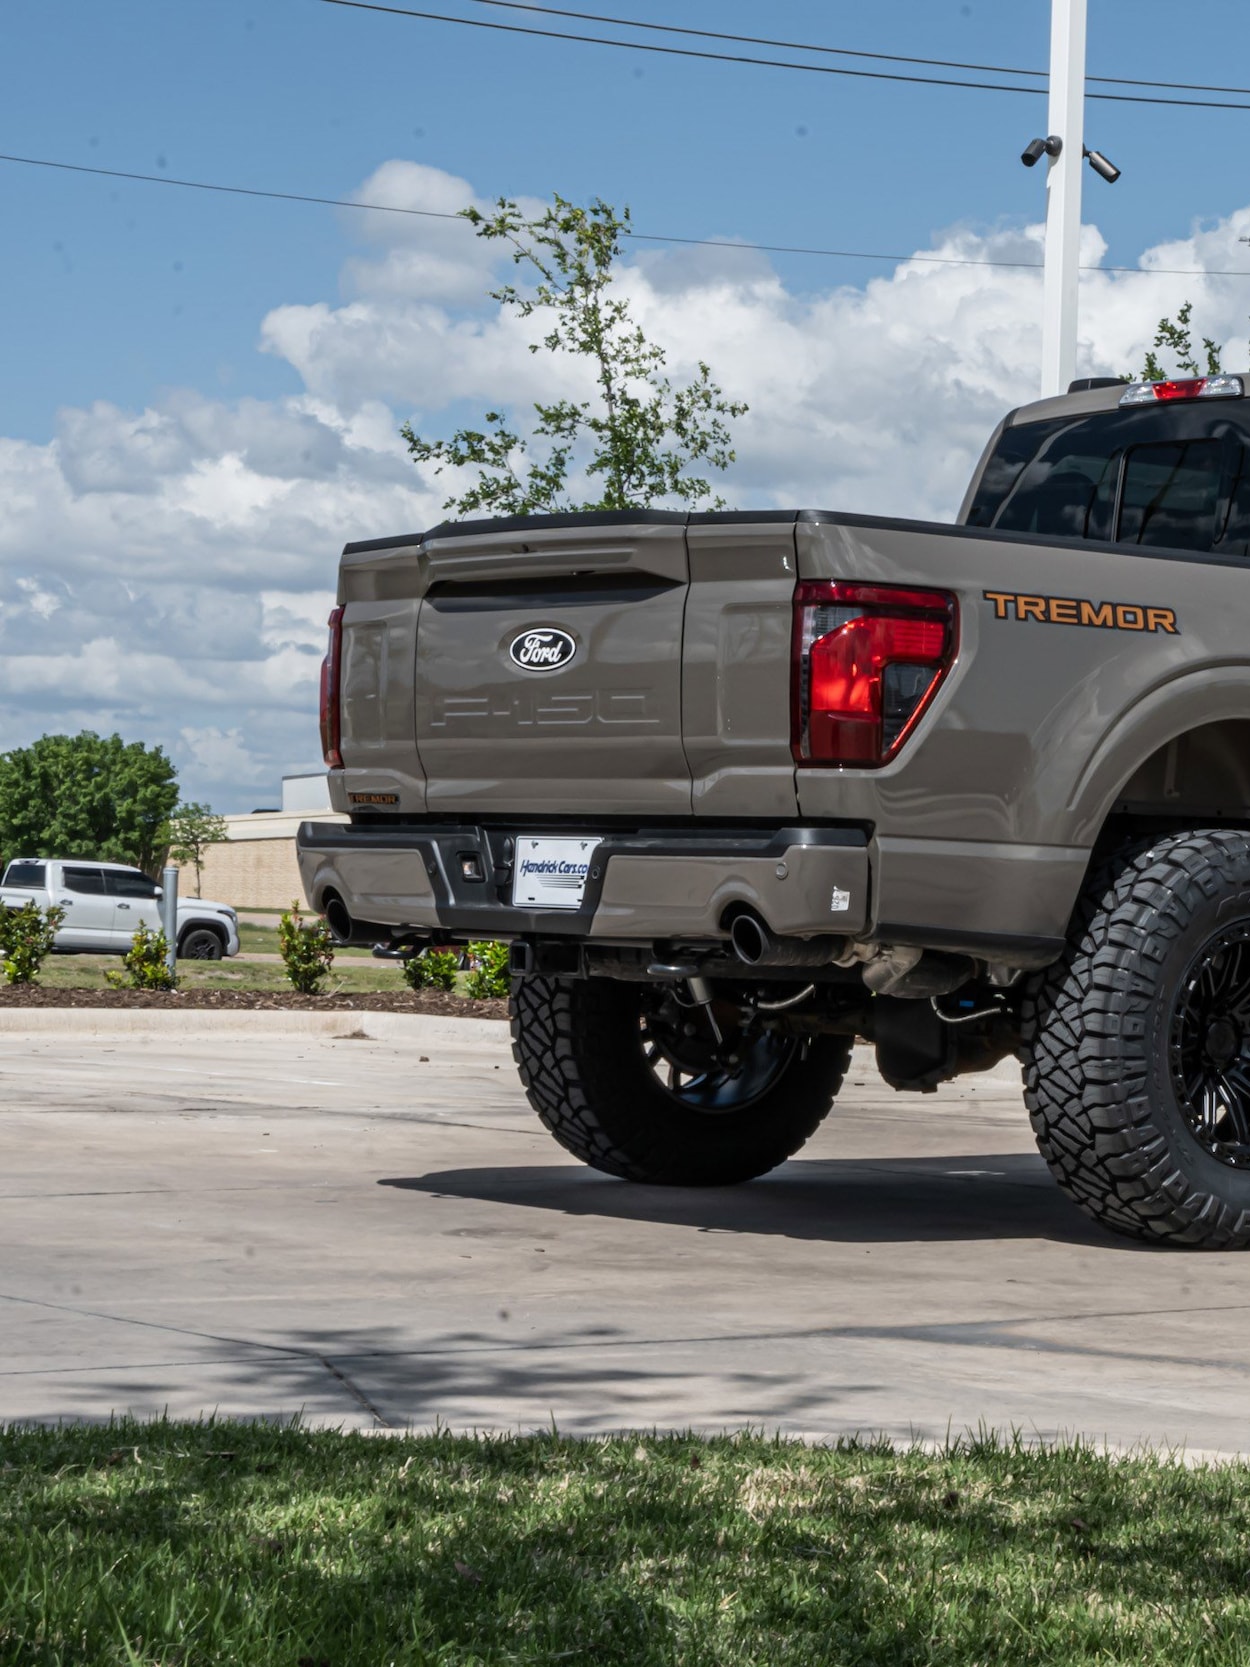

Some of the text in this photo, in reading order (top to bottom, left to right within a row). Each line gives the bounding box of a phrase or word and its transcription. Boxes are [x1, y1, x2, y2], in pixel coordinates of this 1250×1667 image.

[982, 590, 1181, 635] TREMOR
[519, 633, 564, 663] Ford
[430, 688, 660, 726] F-150
[348, 792, 398, 804] TREMOR
